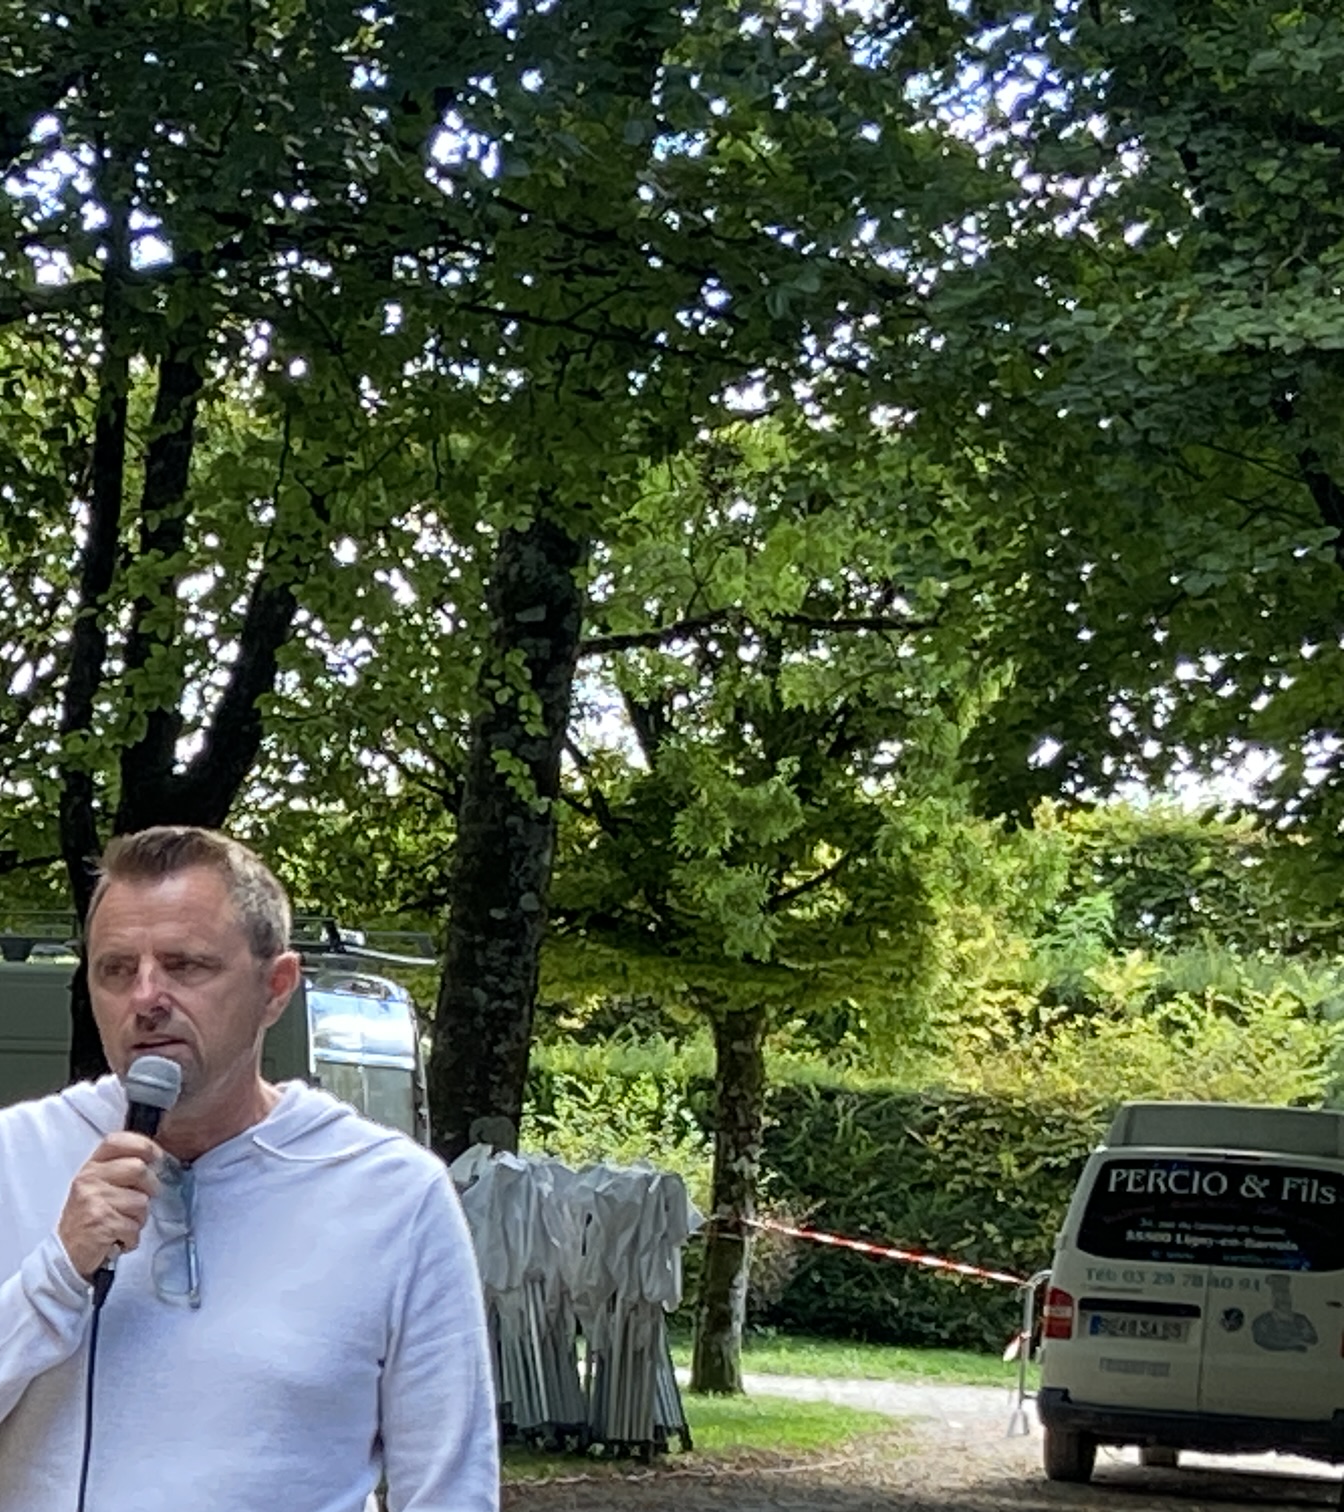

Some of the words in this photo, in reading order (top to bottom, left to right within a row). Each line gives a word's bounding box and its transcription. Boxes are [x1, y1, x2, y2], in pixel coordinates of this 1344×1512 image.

[1108, 1168, 1228, 1196] PERCIO
[1240, 1174, 1270, 1199] &
[1281, 1177, 1337, 1205] Fils
